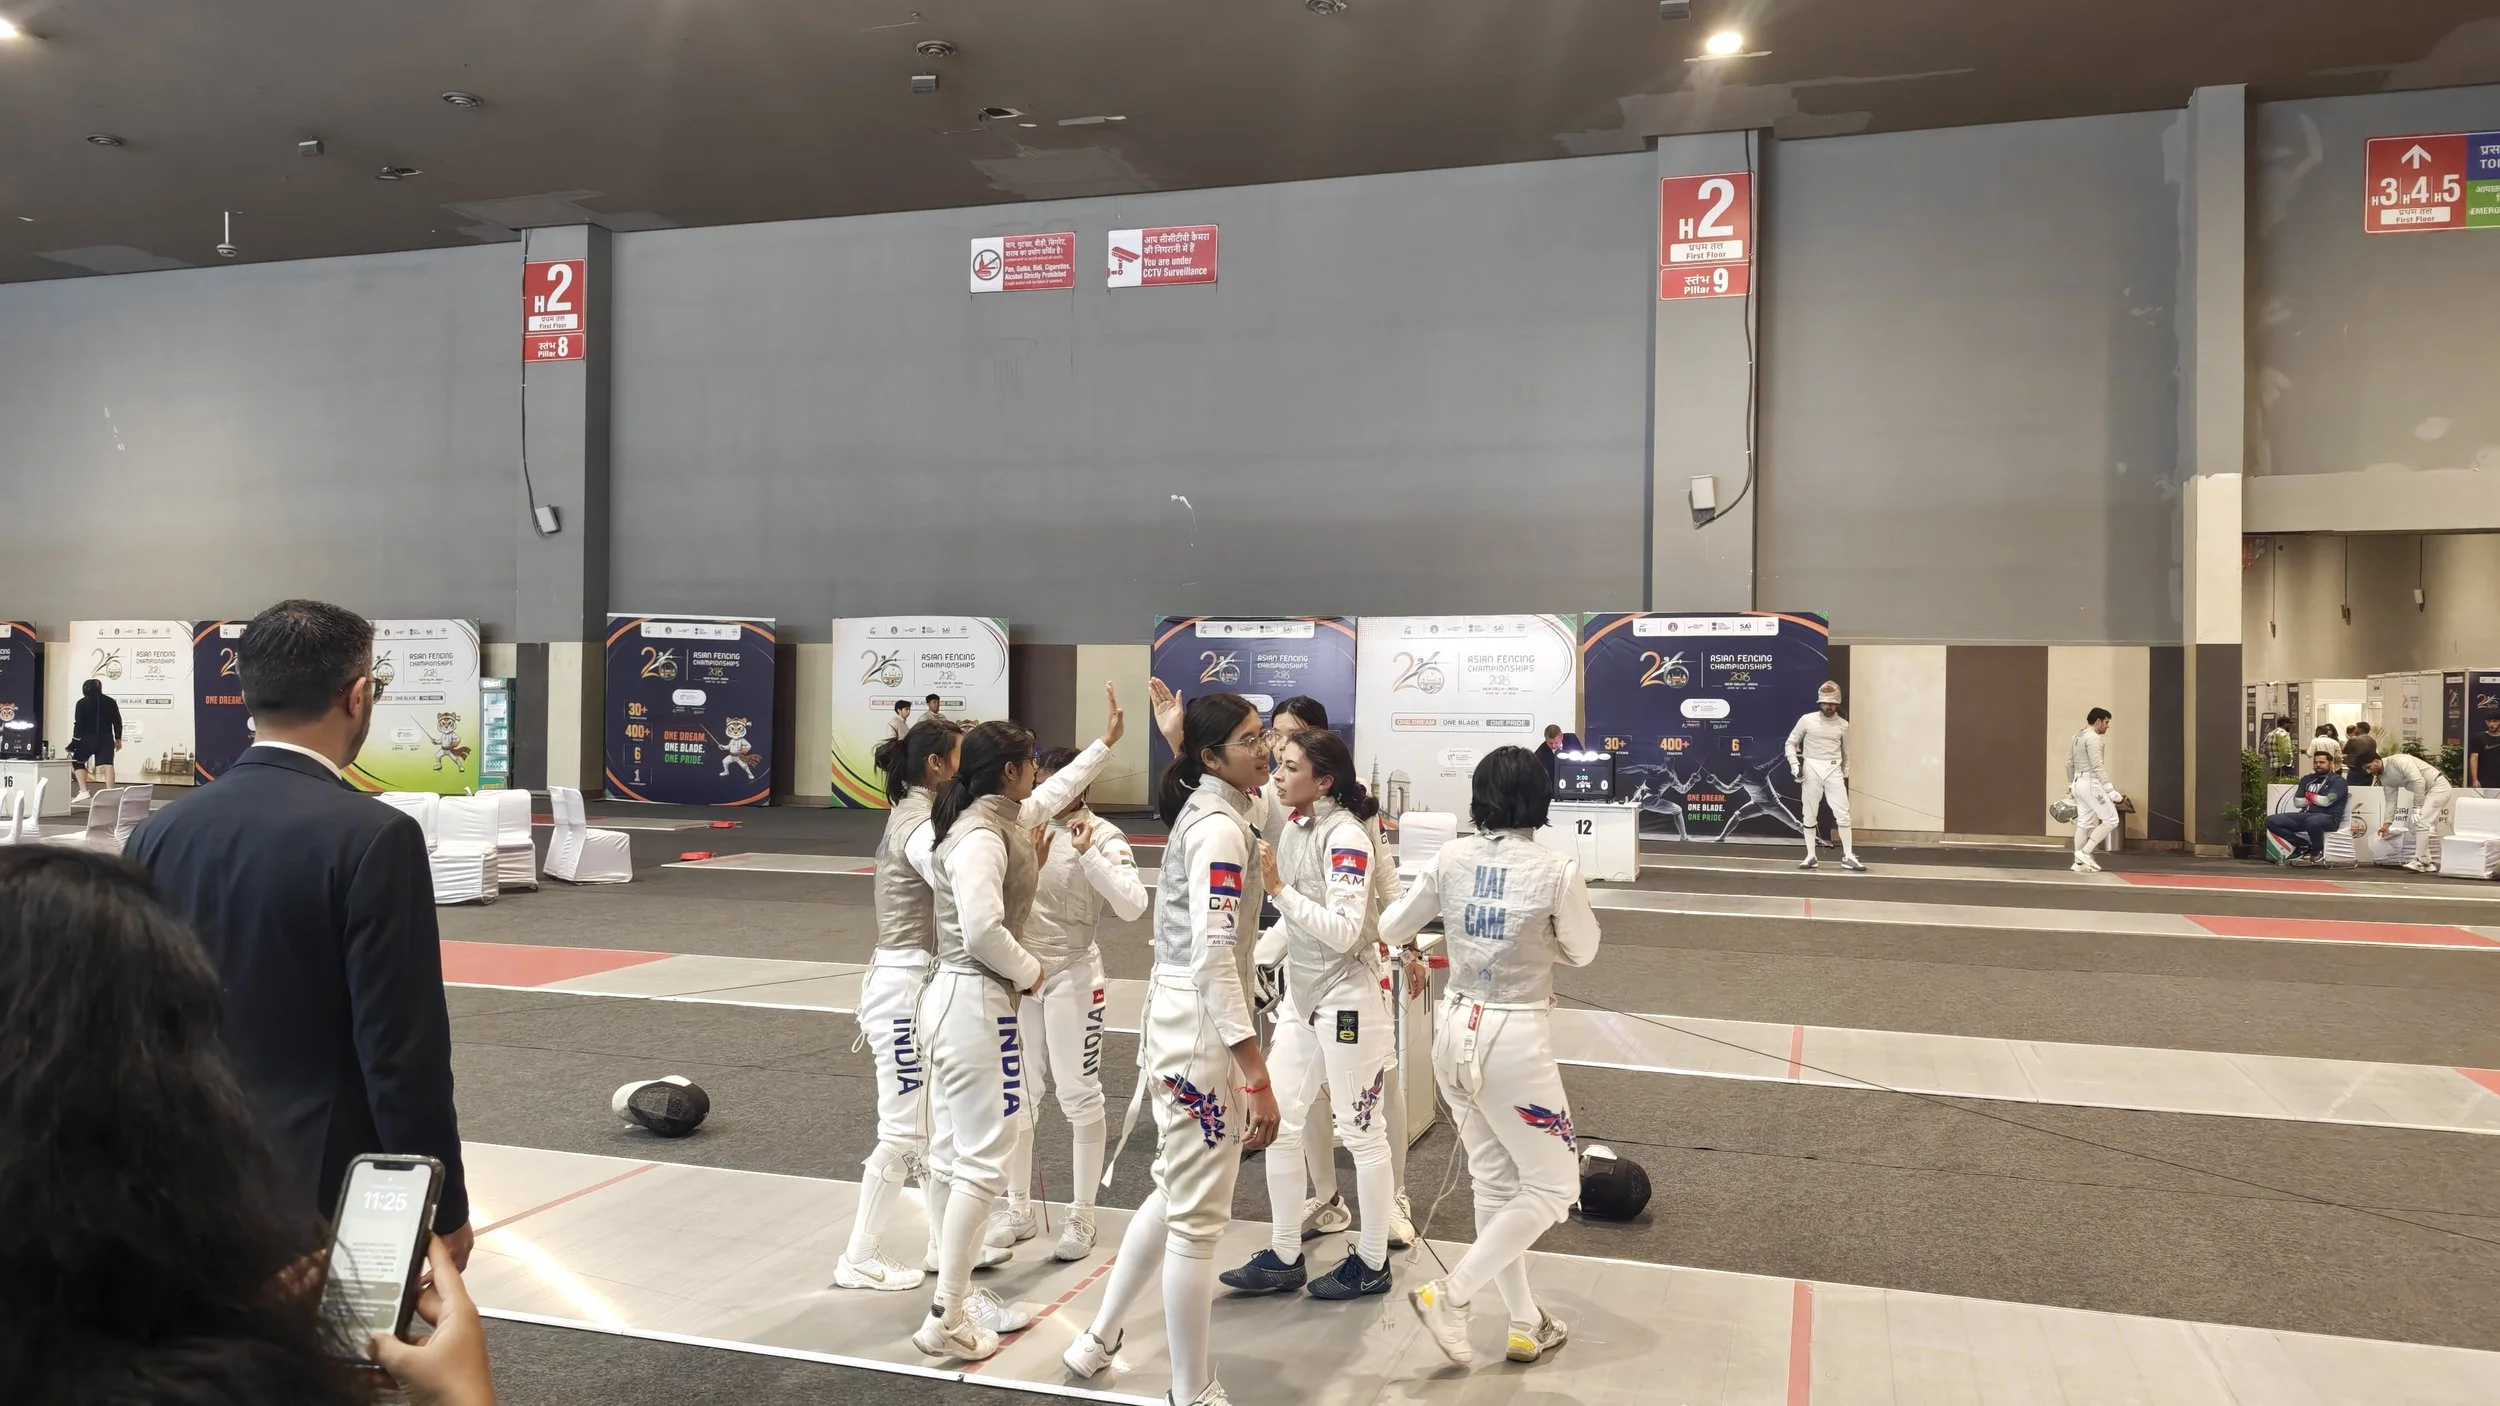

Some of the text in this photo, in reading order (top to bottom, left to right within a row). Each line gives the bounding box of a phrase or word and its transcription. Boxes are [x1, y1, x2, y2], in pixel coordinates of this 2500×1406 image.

[1689, 243, 1708, 251] प्रथम
[1143, 257, 1156, 267] You
[1172, 256, 1192, 265] under
[1024, 272, 1041, 280] Strictly
[1042, 271, 1066, 279] Prohibited
[1143, 267, 1208, 278] CCTV Surveillance
[1684, 274, 1711, 286] स्तंभ
[1684, 267, 1729, 295] Pillar 9
[538, 340, 556, 350] स्तंभ
[557, 336, 569, 357] 8
[428, 652, 454, 660] FENCING
[693, 651, 740, 660] ASIAN FENCING
[1467, 654, 1535, 664] ASIAN FENCING
[1710, 654, 1773, 663] ASIAN FENCING
[206, 696, 218, 704] ONE
[628, 702, 648, 716] 30+
[625, 724, 651, 738] 400+
[664, 731, 707, 742] ONE DREAM.
[664, 742, 705, 753] ONE BLADE.
[1604, 737, 1627, 750] 30+
[1660, 737, 1690, 751] 400+
[1731, 738, 1740, 751] 6
[634, 747, 641, 760] 6
[664, 754, 704, 765] ONE PRIDE.
[4, 775, 13, 788] 16
[634, 769, 640, 782] 1
[1559, 779, 1566, 789] 0
[1601, 780, 1608, 790] 0
[1687, 794, 1726, 802] ONE DREAM.
[1687, 804, 1725, 812] ONE BLADE.
[1687, 813, 1724, 822] ONE PRIDE.
[1576, 819, 1592, 835] 12
[1331, 873, 1365, 886] CAM
[1472, 865, 1508, 900] HAI
[1465, 903, 1507, 940] CAM
[1083, 1005, 1106, 1076] INDIA
[893, 1019, 924, 1096] INDIA
[997, 1016, 1021, 1118] INDIA
[364, 1191, 408, 1211] 11:25
